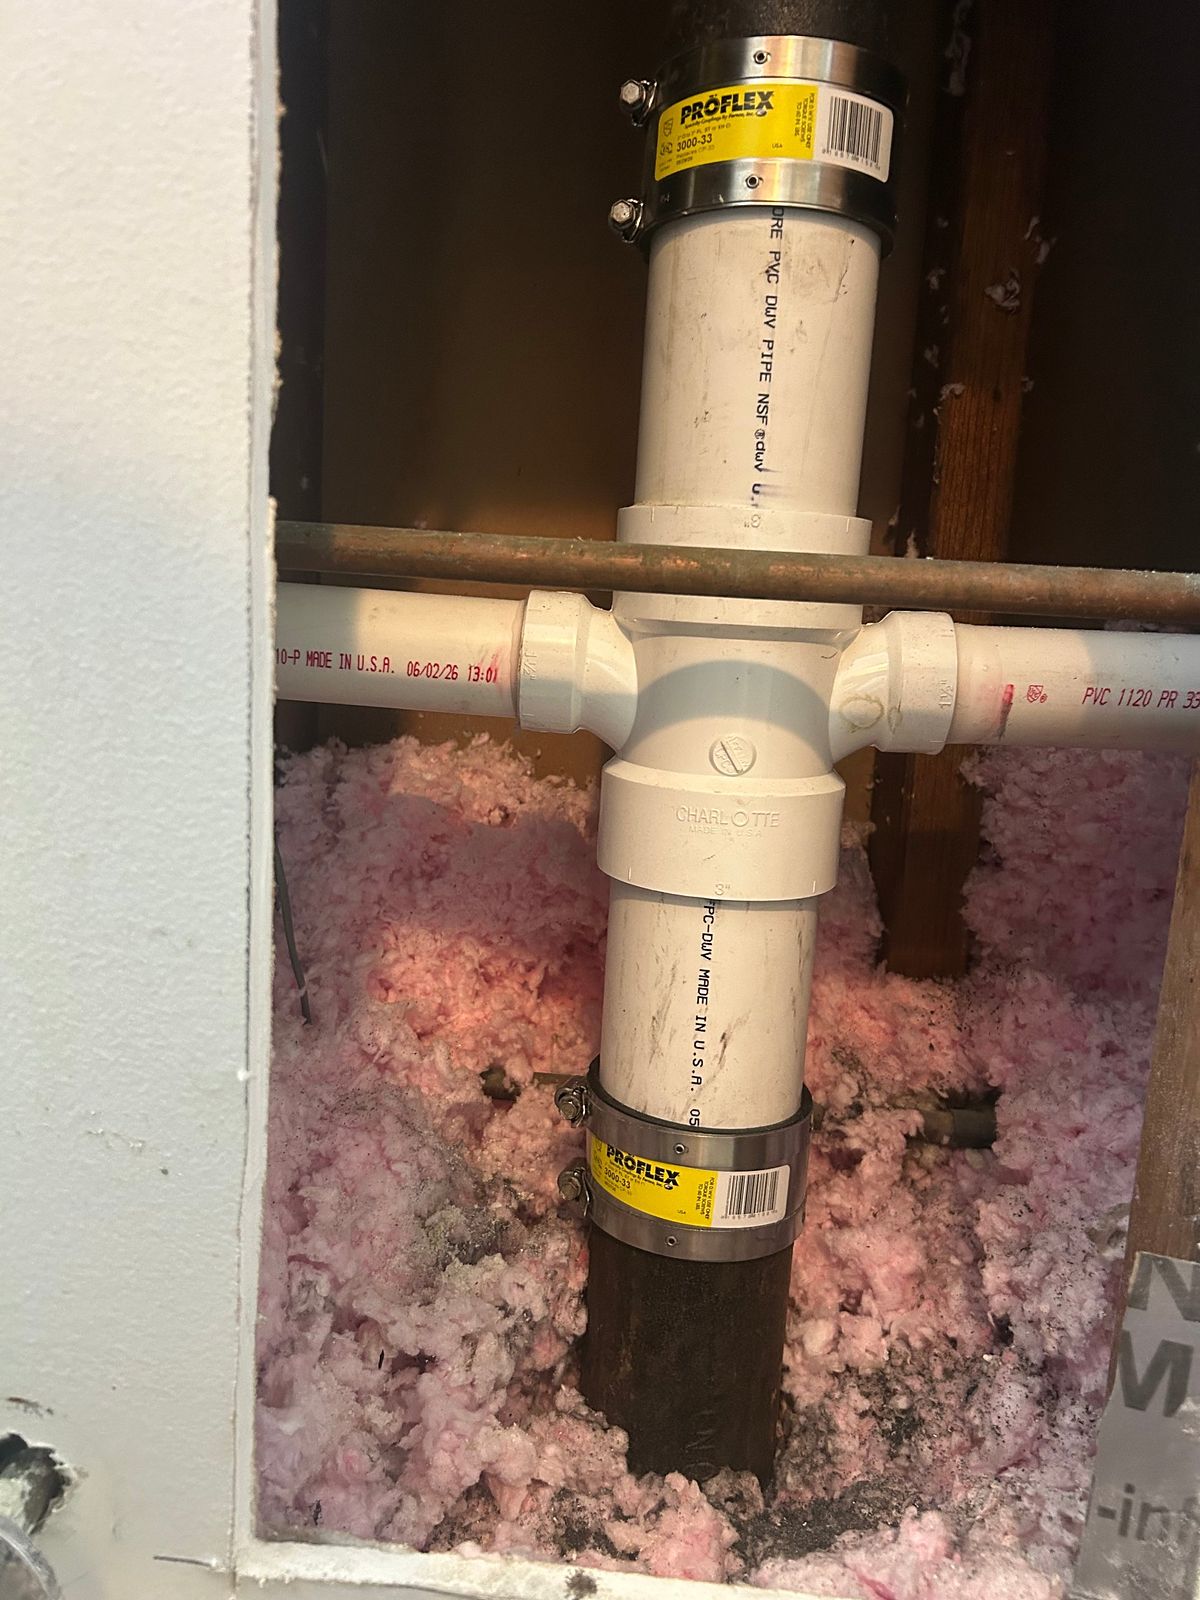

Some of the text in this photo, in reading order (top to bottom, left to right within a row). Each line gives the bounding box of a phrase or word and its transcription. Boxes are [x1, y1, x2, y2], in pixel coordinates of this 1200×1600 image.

[676, 133, 713, 152] 3000-33
[766, 250, 780, 284] PVC
[763, 295, 777, 328] DWV
[759, 339, 774, 382] PIPE
[756, 393, 770, 426] NSF
[306, 651, 333, 670] MADE
[339, 653, 352, 670] IN
[357, 655, 396, 675] U.S.A.
[406, 662, 459, 681] 06/02/26
[467, 664, 499, 684] 13:01
[1082, 687, 1111, 705] PVC
[1117, 688, 1153, 707] 1120
[1157, 690, 1178, 708] PR
[676, 806, 780, 828] CHARLOTTE
[697, 969, 710, 1005] MADE
[694, 1015, 706, 1032] IN
[690, 1041, 705, 1092] U.S.A.
[604, 1167, 631, 1189] 3000-33
